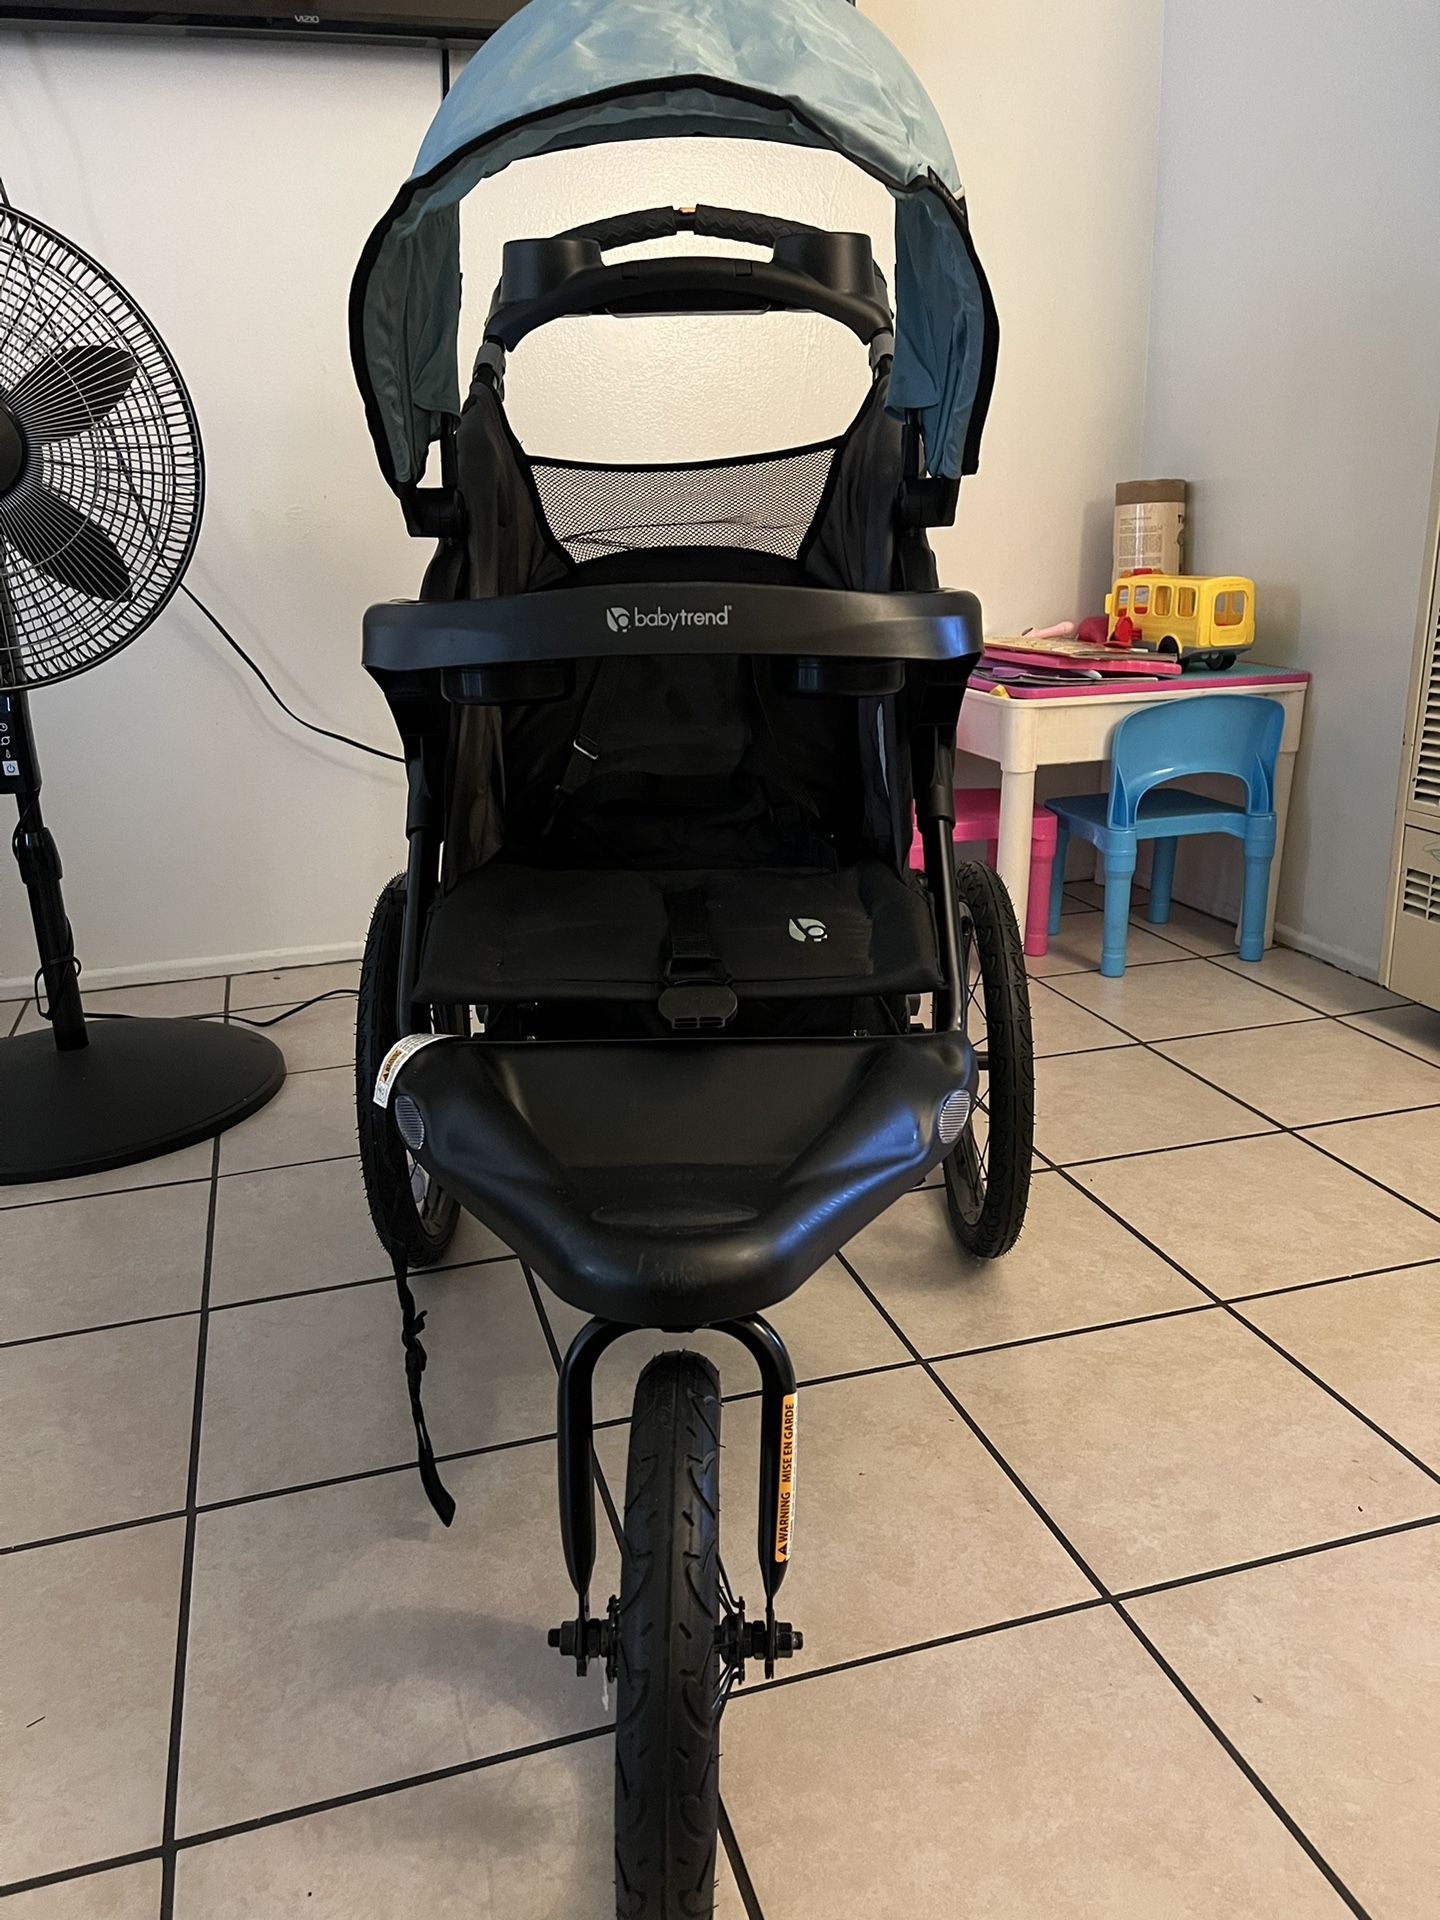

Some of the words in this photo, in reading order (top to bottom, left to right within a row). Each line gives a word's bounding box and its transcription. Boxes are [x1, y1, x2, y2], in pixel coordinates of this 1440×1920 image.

[294, 15, 320, 24] VIZIO
[634, 605, 729, 631] babytrend
[784, 1403, 794, 1440] GARDE
[783, 1441, 793, 1456] EN
[782, 1457, 792, 1483] MISE
[778, 1492, 791, 1543] WARNING
